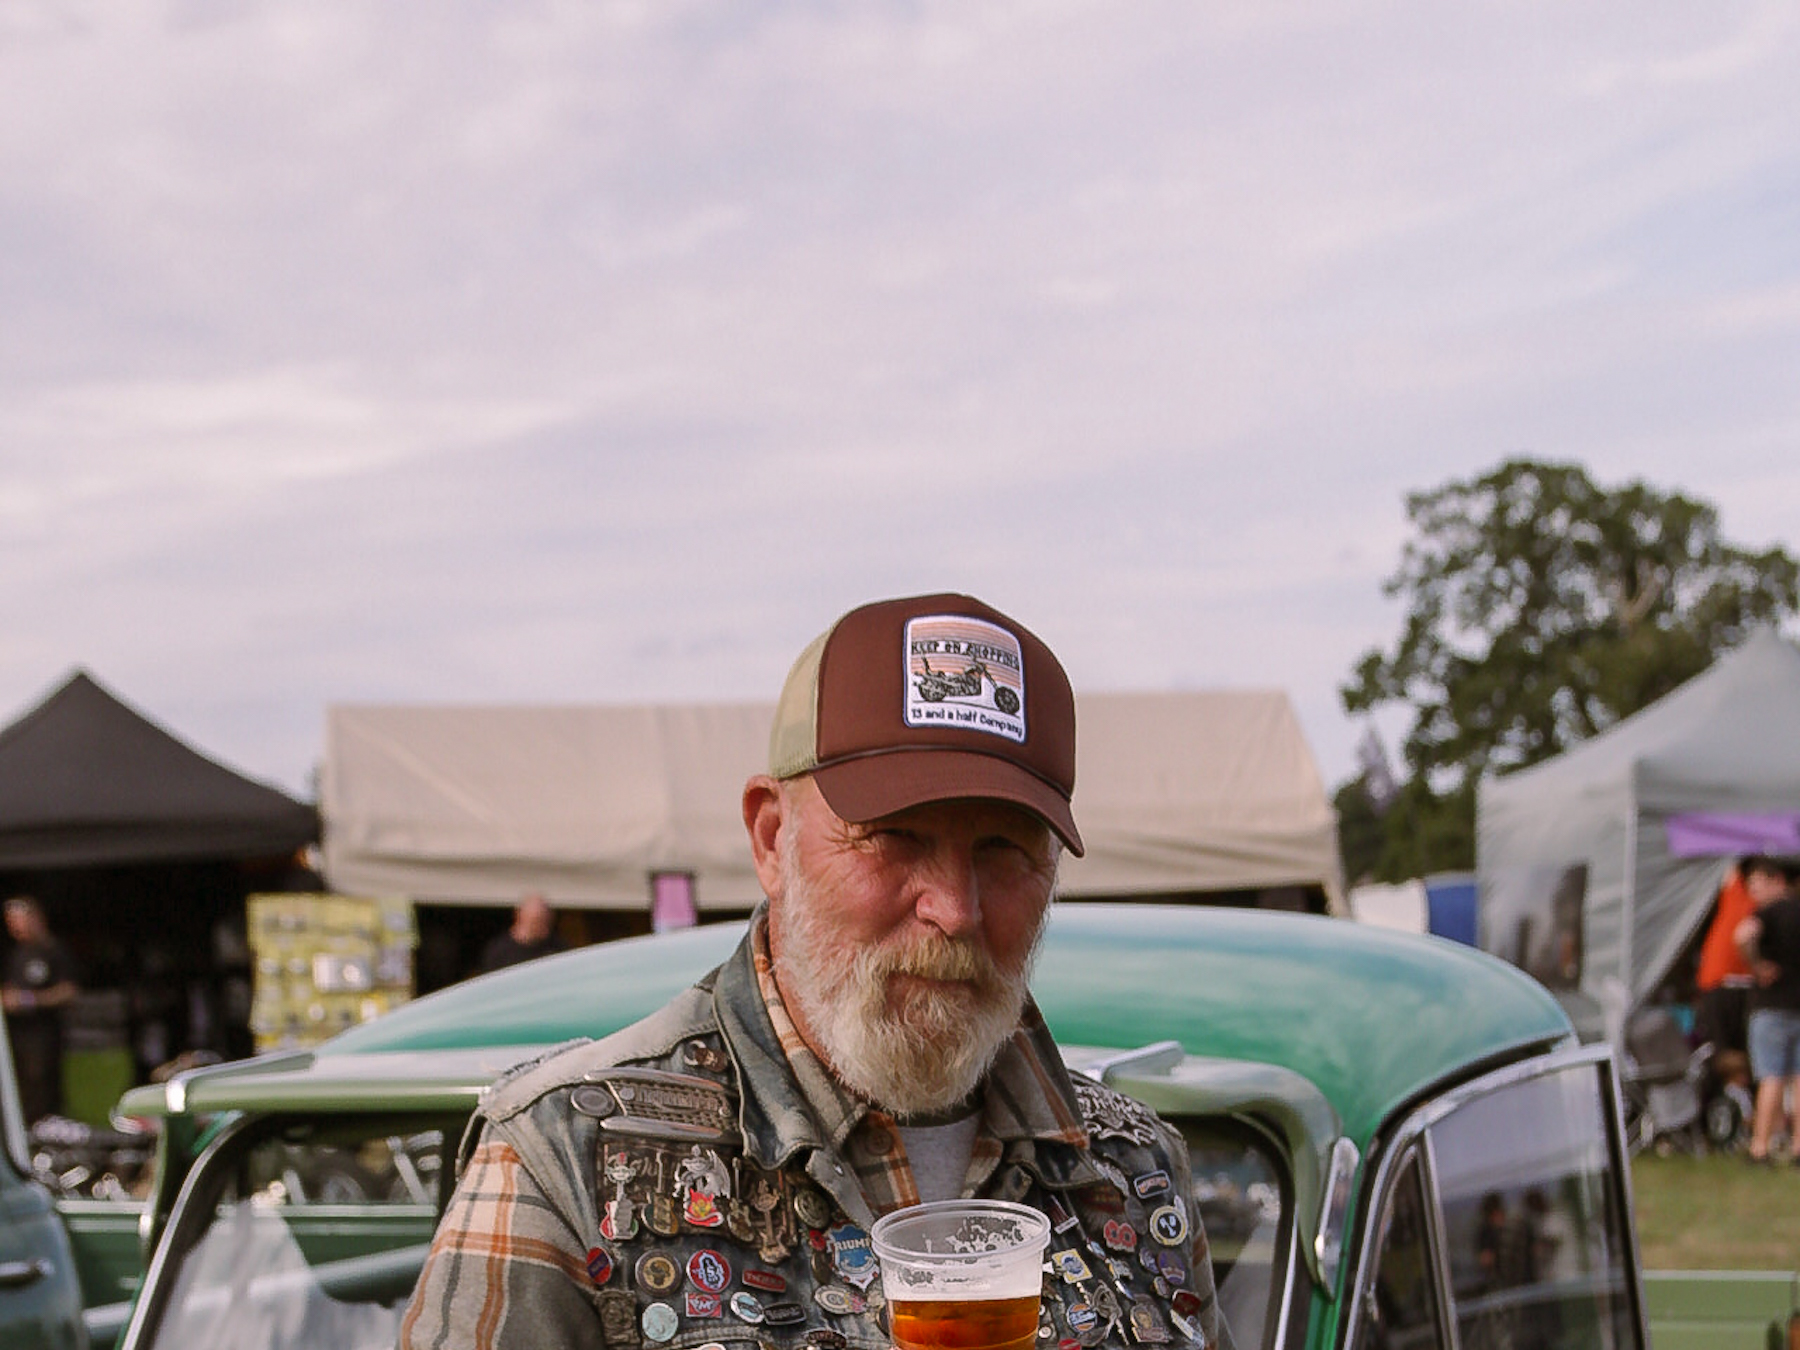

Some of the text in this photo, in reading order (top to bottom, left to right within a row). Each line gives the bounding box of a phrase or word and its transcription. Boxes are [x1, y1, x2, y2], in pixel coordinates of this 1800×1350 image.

[912, 641, 940, 655] KEEP
[945, 642, 961, 655] ON
[911, 708, 923, 719] 13
[926, 708, 946, 719] and
[956, 710, 978, 723] half
[980, 714, 1022, 738] Company
